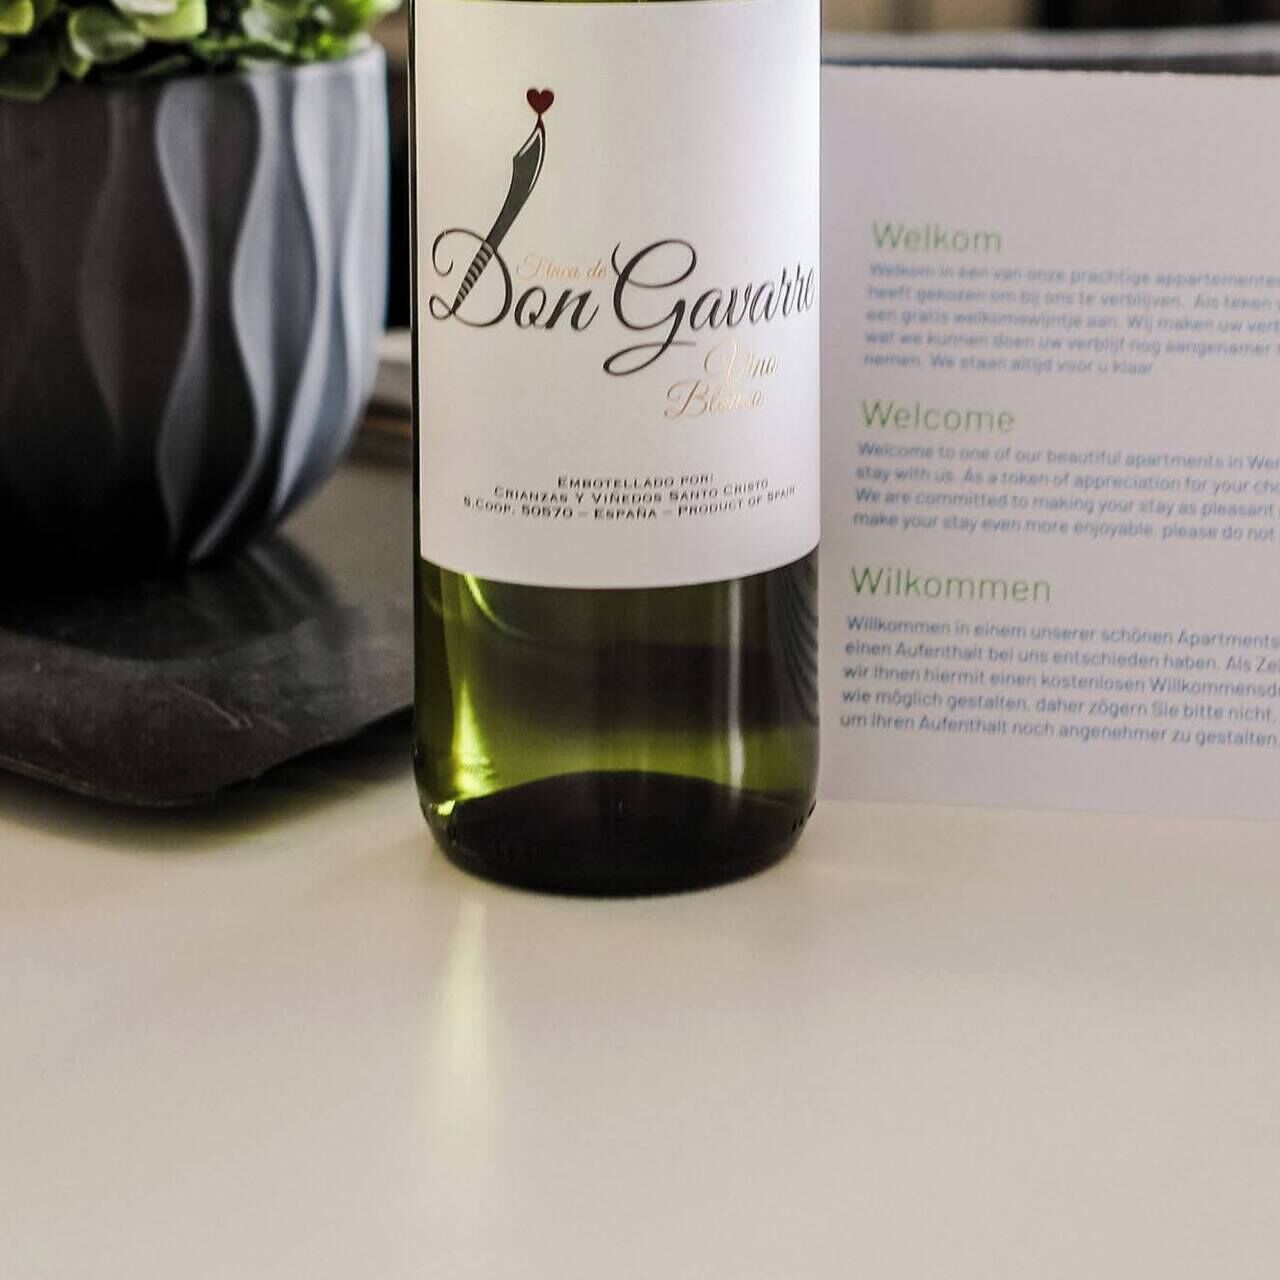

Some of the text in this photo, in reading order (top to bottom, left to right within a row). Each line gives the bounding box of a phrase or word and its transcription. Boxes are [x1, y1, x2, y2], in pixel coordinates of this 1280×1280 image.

[872, 220, 1003, 253] Welkom
[429, 210, 599, 332] Don
[862, 401, 1015, 432] Welcome
[856, 442, 934, 459] Welcome
[936, 445, 956, 460] to
[958, 449, 990, 461] one
[992, 447, 1011, 461] of
[1014, 451, 1042, 462] our
[1044, 448, 1122, 465] beautiful
[1124, 453, 1224, 469] apartments
[1226, 455, 1244, 469] in
[575, 492, 585, 504] Y
[669, 487, 719, 501] SANTO
[723, 478, 769, 496] CRISTO
[854, 466, 890, 484] stay
[893, 467, 932, 482] with
[961, 468, 984, 484] As
[986, 473, 998, 484] a
[1000, 470, 1050, 486] token
[1052, 472, 1069, 486] of
[1072, 475, 1181, 491] appreciation
[1182, 476, 1207, 491] for
[1211, 480, 1248, 495] your
[593, 506, 657, 520] ESPAÑA
[677, 498, 744, 518] PRODUCT
[748, 494, 762, 508] OF
[767, 485, 797, 502] SPAIN
[851, 512, 899, 527] make
[900, 516, 938, 531] your
[941, 515, 978, 534] stay
[980, 519, 1022, 532] even
[1024, 521, 1069, 533] more
[1160, 523, 1218, 541] please
[1220, 525, 1244, 540] do
[1246, 527, 1274, 541] not
[851, 565, 1052, 603] Wilkommen
[845, 616, 951, 634] Willkommen
[954, 621, 970, 635] in
[972, 622, 1027, 637] einem
[1029, 627, 1095, 640] unserer
[1099, 626, 1174, 643] schönen
[1176, 628, 1280, 647] Apartments
[843, 641, 892, 656] einen
[894, 642, 983, 660] Aufenthalt
[986, 645, 1014, 661] bei
[1016, 650, 1049, 662] uns
[1051, 650, 1160, 667] entschieden
[1224, 655, 1252, 670] Als
[841, 665, 868, 679] wir
[872, 665, 921, 682] Ihnen
[922, 667, 985, 684] hiermit
[988, 671, 1037, 686] einen
[1039, 672, 1146, 691] kostenlosen
[840, 689, 872, 704] wie
[874, 691, 943, 709] möglich
[1034, 697, 1084, 713] daher
[1087, 700, 1148, 718] zögern
[1150, 702, 1179, 717] Sie
[1182, 703, 1224, 719] bitte
[838, 716, 868, 727] um
[869, 713, 915, 730] Ihren
[918, 716, 1008, 734] Aufenthalt
[1010, 721, 1055, 736] noch
[1057, 725, 1166, 741] angenehmer
[1170, 731, 1192, 742] zu
